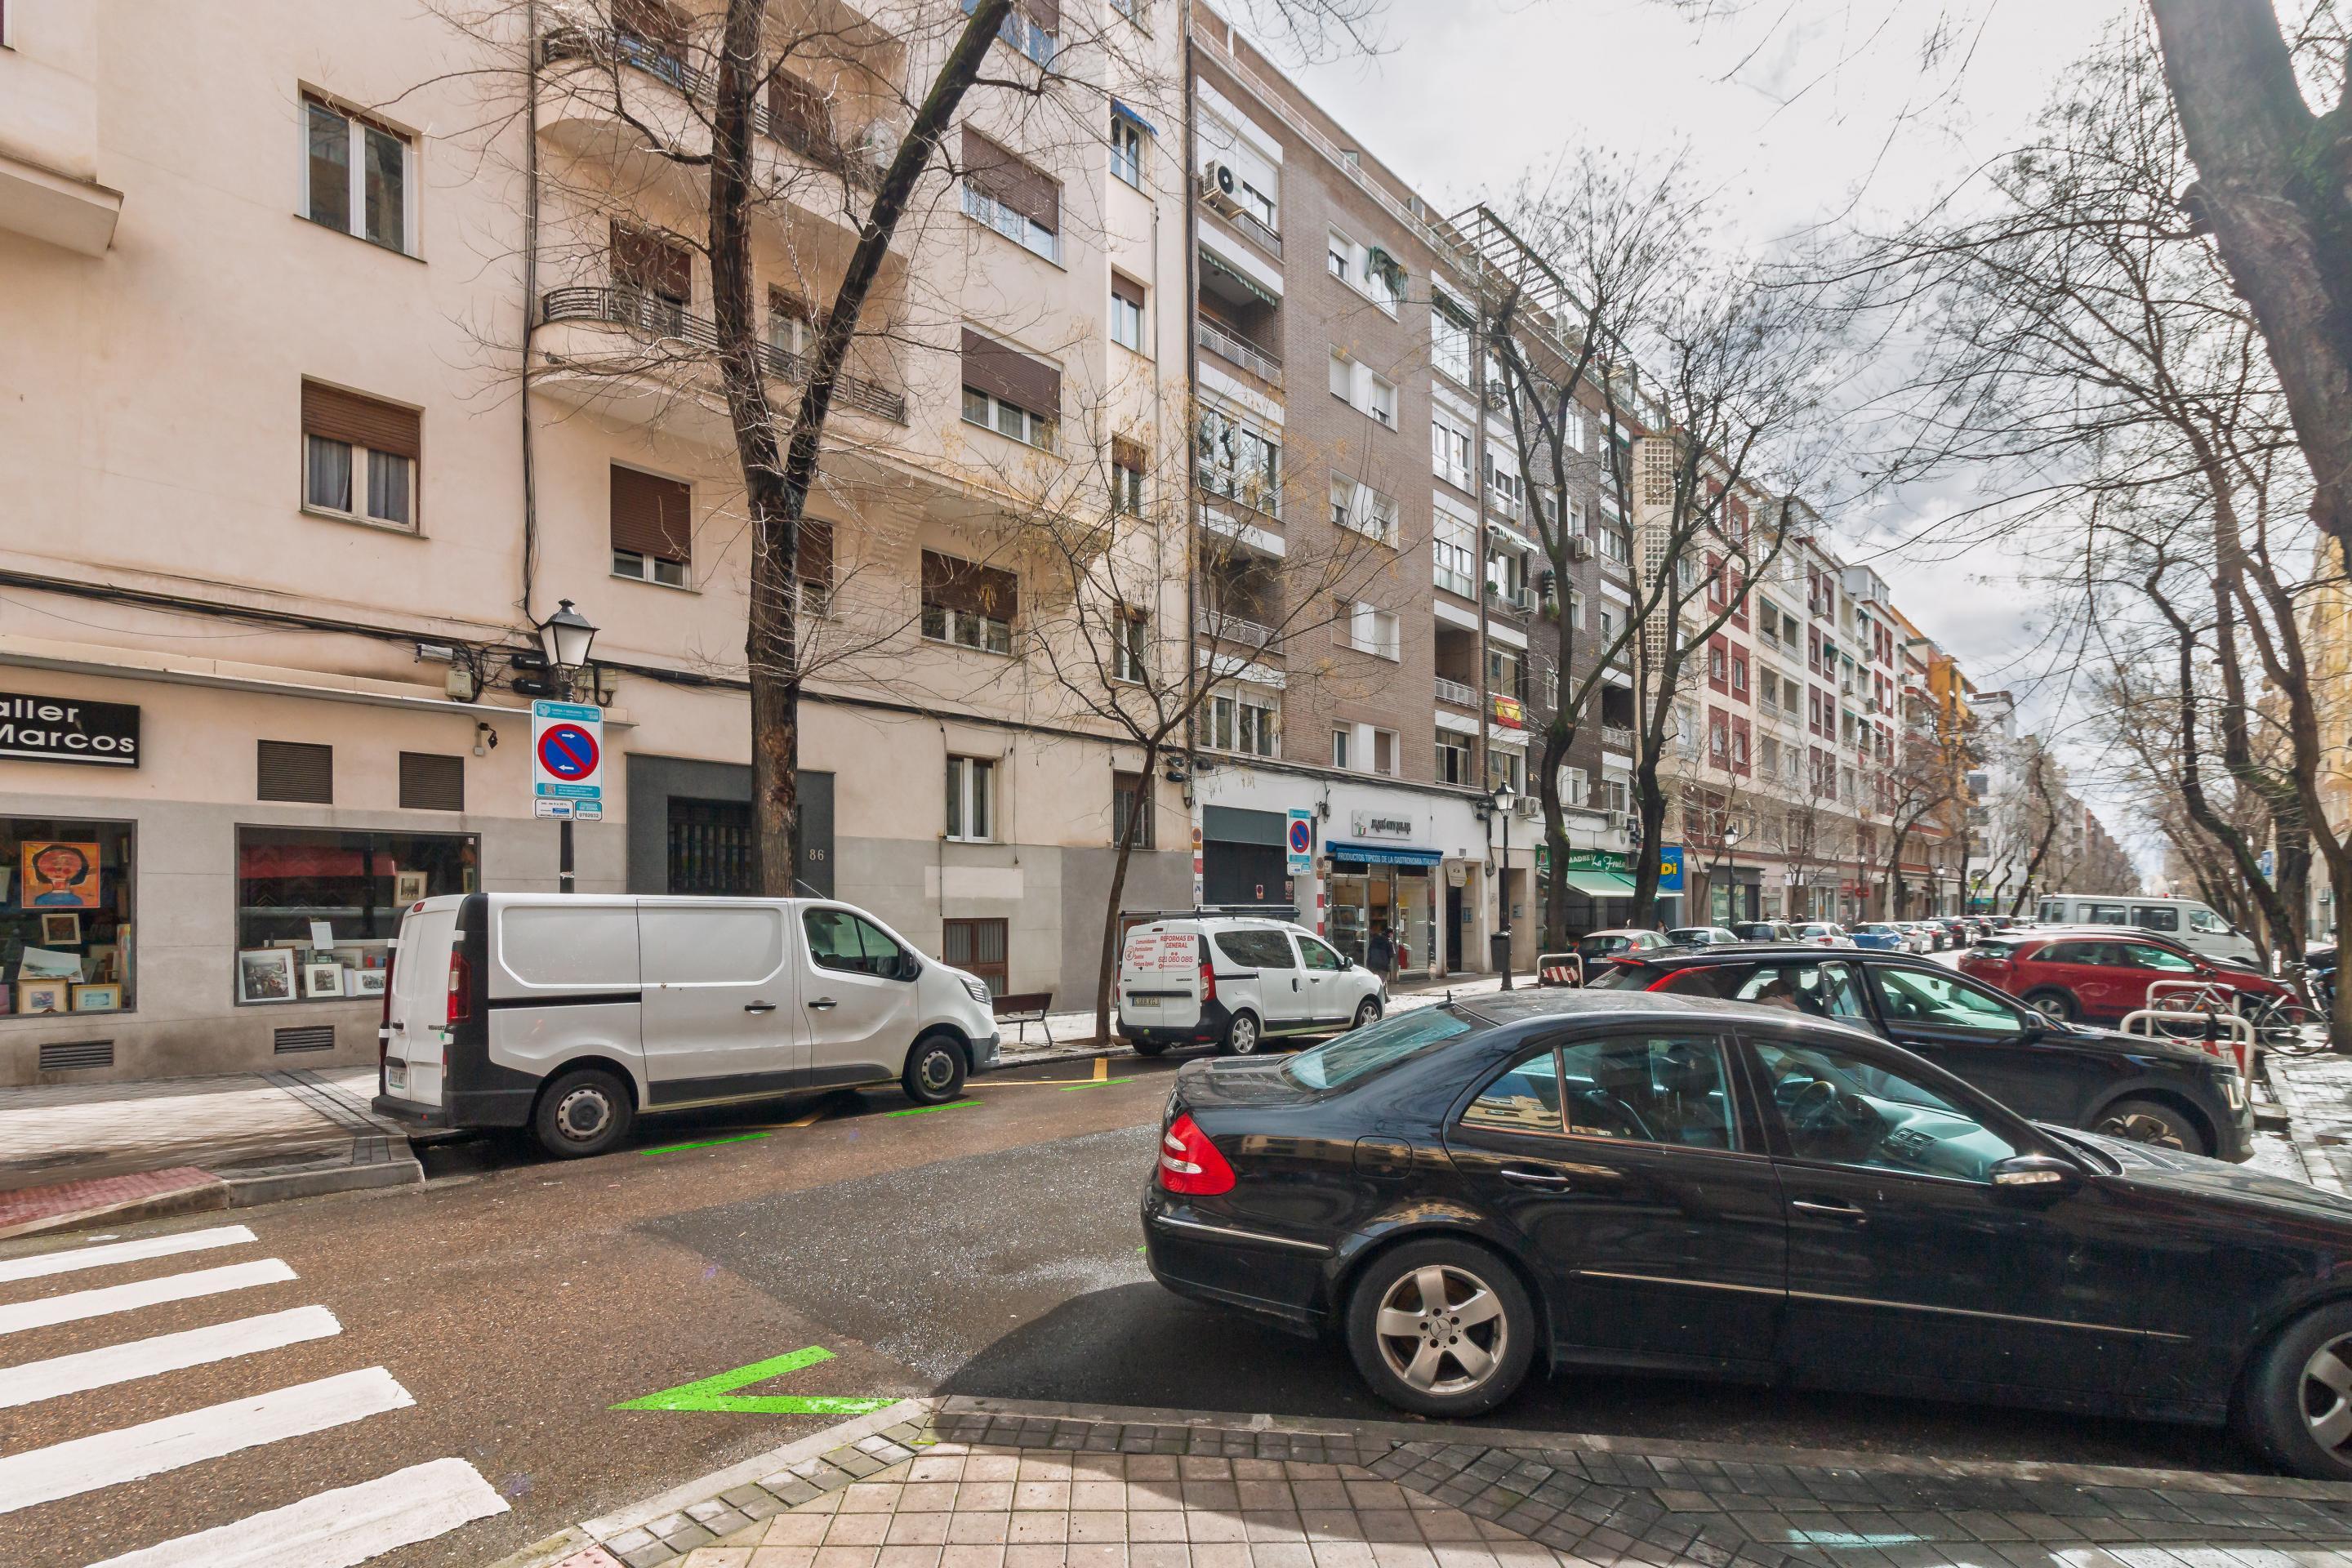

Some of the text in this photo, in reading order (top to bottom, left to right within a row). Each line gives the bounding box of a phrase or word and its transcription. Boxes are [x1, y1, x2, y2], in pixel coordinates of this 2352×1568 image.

[809, 849, 824, 861] 86
[1338, 852, 1365, 862] PRODUCTOS
[1381, 855, 1388, 863] DE
[1388, 856, 1393, 864] LA
